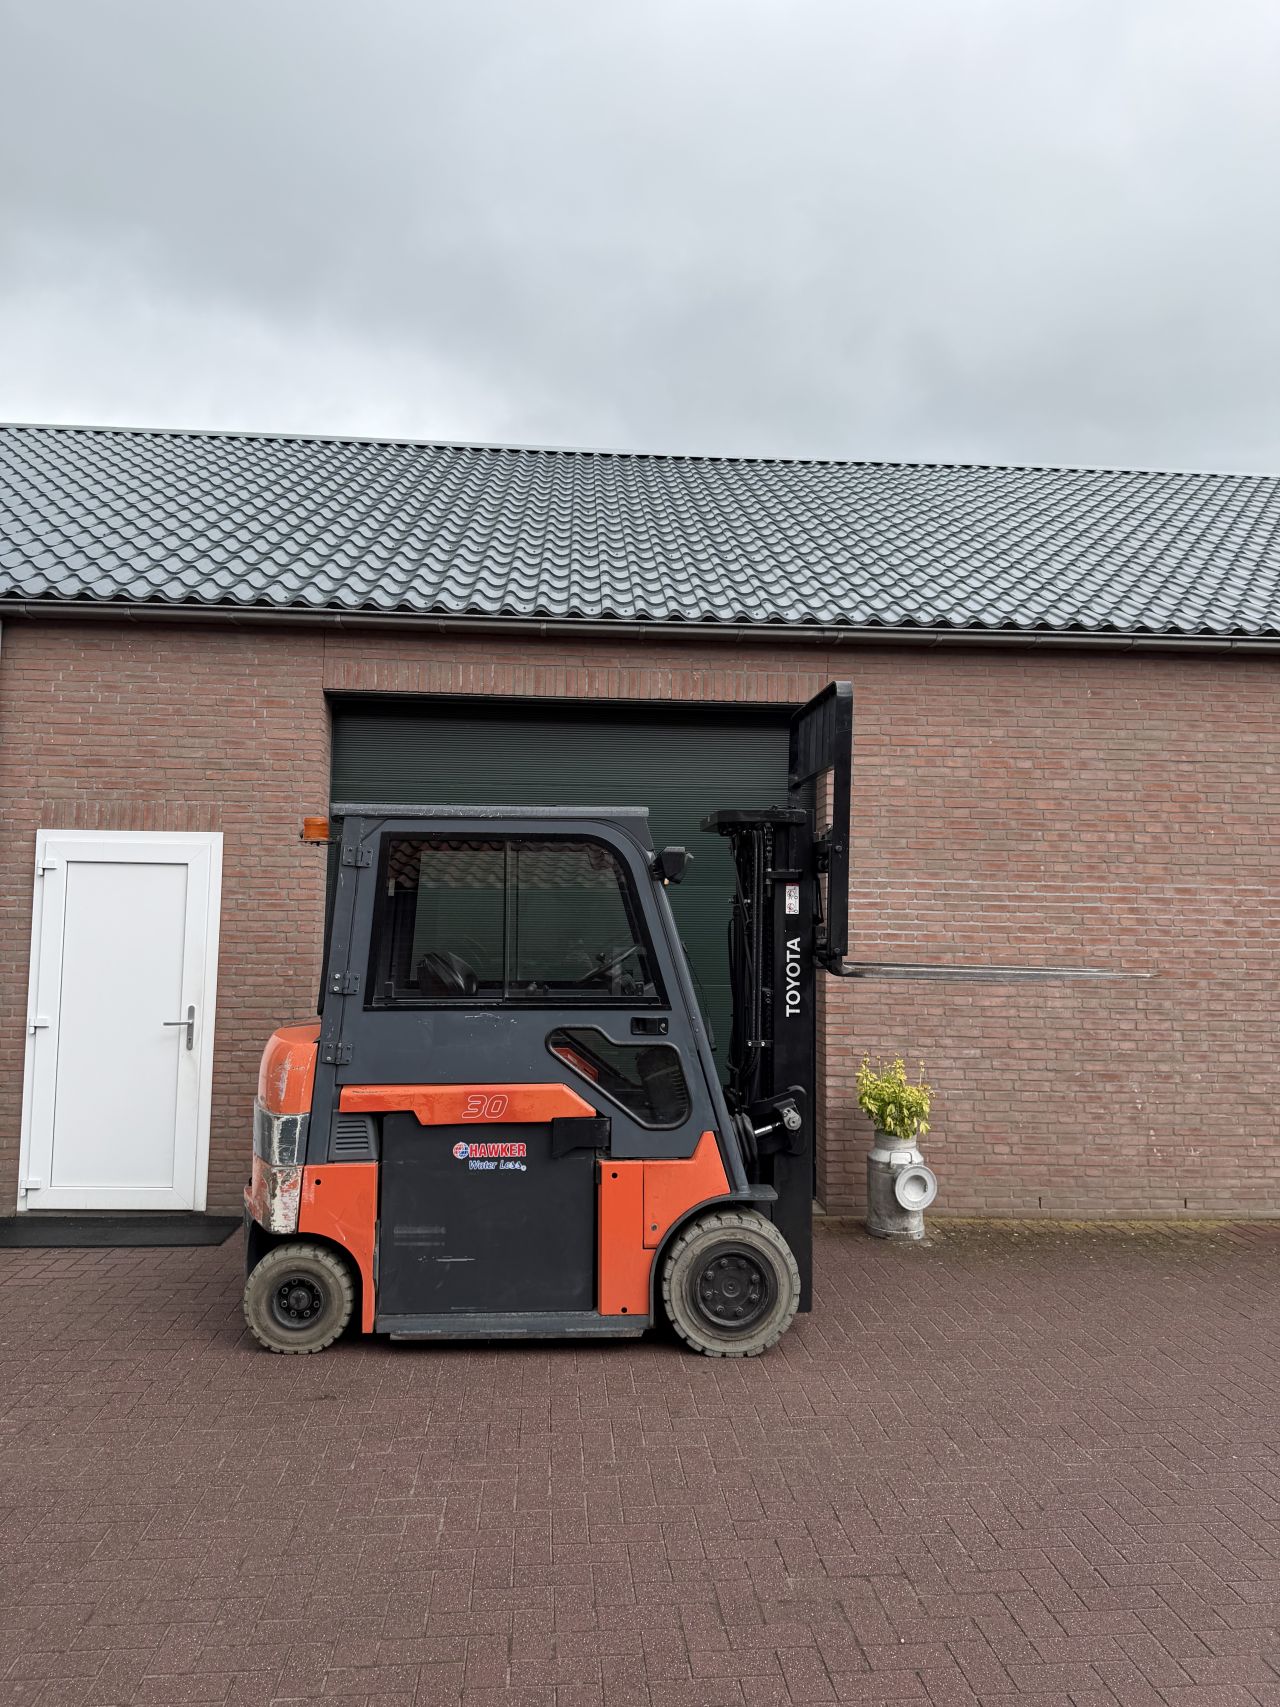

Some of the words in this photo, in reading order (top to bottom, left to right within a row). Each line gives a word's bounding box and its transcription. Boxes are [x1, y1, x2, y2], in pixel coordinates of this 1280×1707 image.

[786, 937, 800, 1017] TOYOTA
[462, 1095, 508, 1118] 30
[469, 1143, 526, 1157] HAWKER
[468, 1160, 497, 1170] Water
